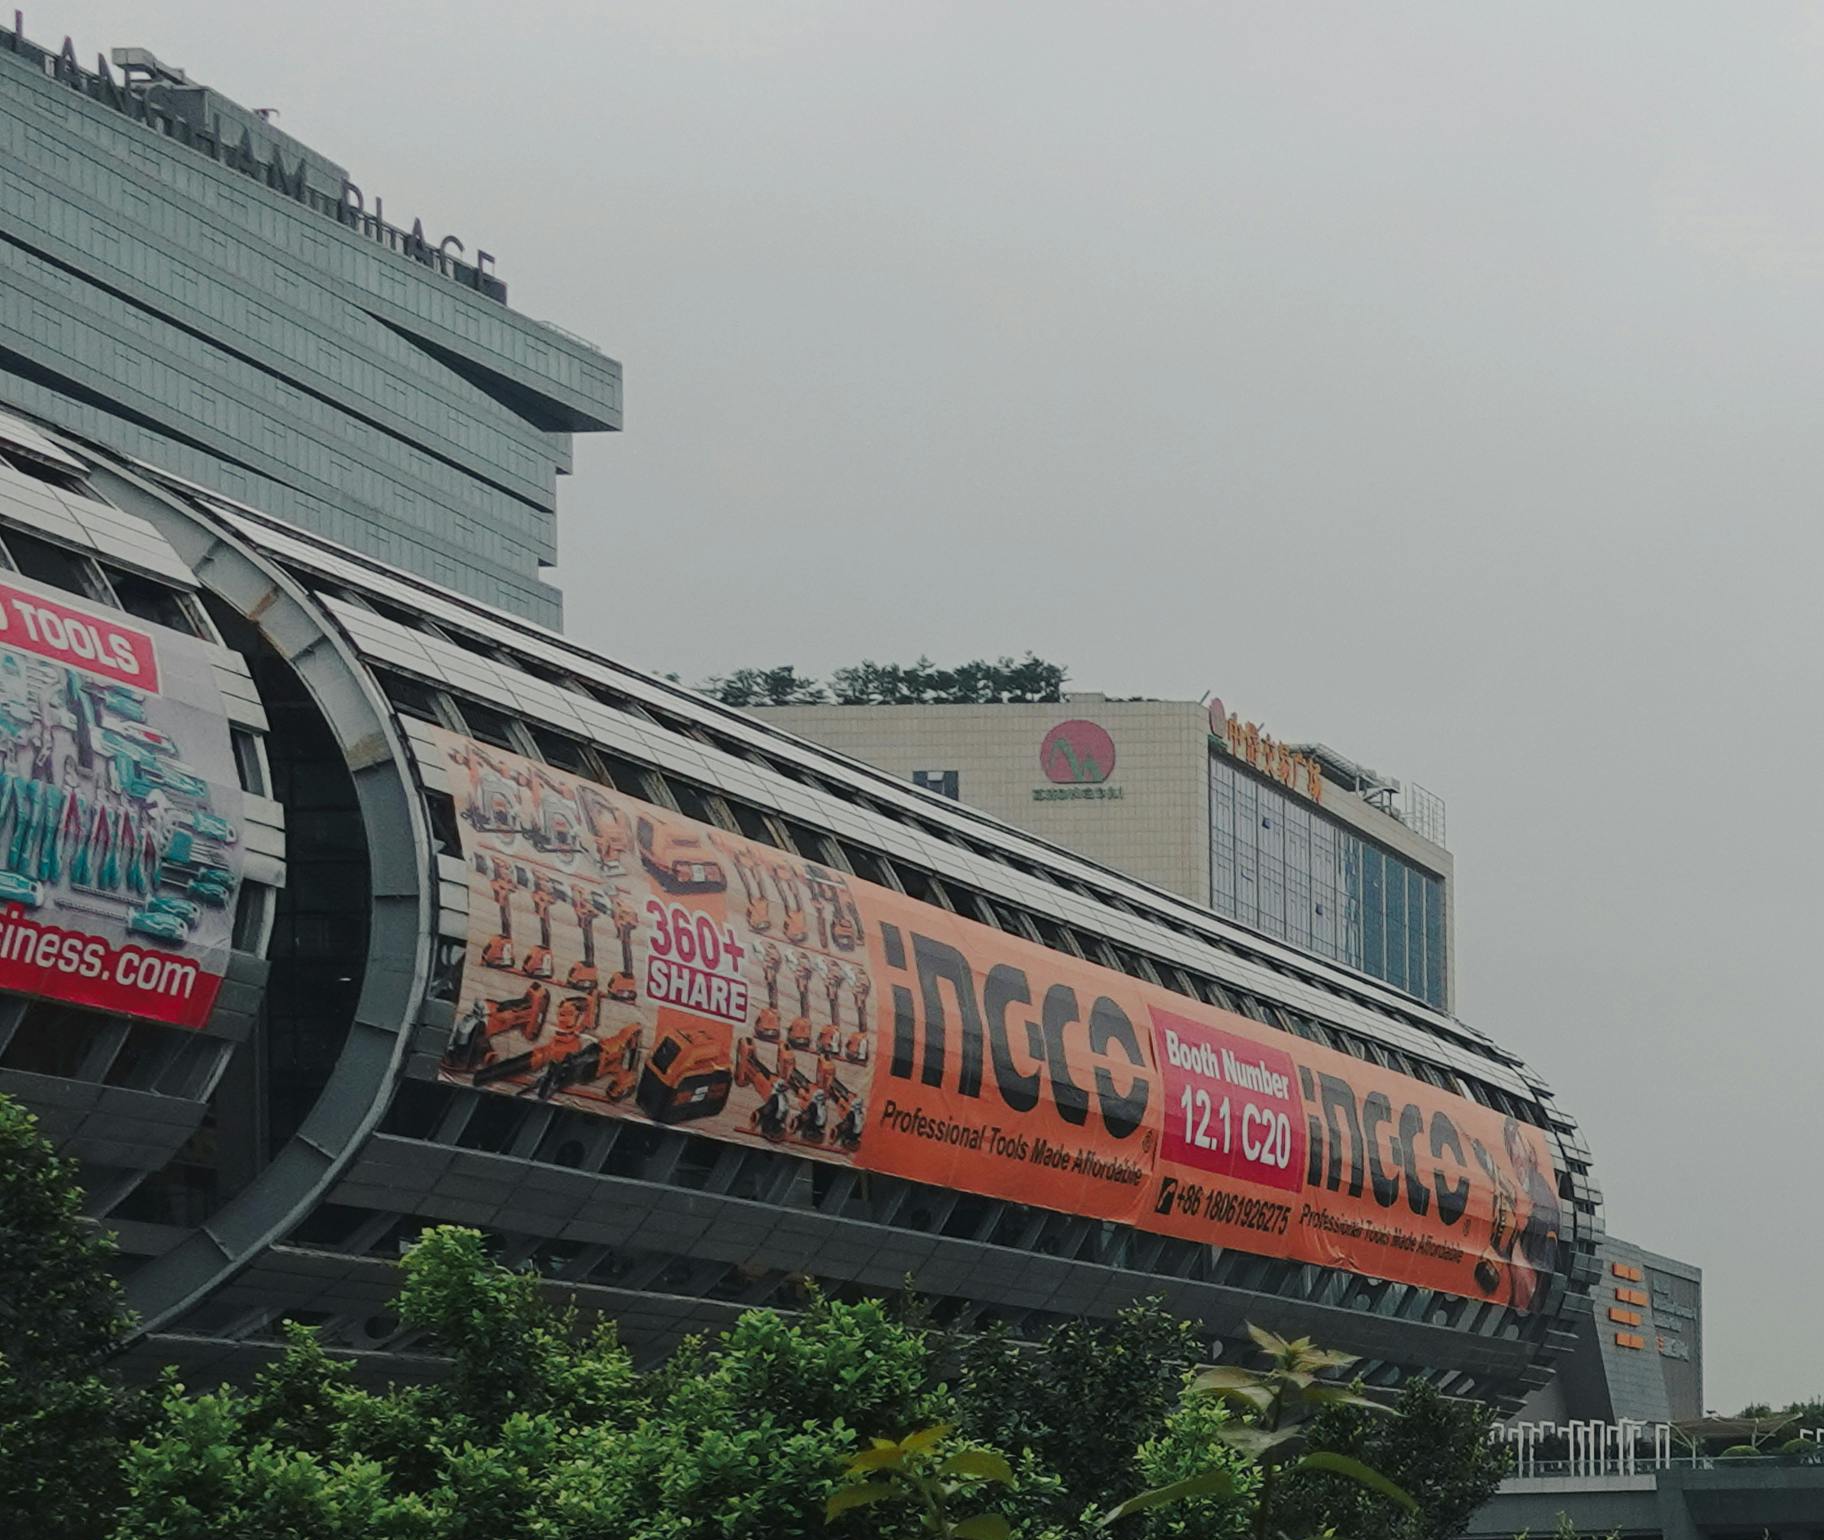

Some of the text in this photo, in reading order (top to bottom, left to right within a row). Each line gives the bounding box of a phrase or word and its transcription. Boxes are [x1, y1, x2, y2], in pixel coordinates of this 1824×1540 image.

[11, 598, 140, 675] TOOLS
[0, 909, 196, 999] iness.com
[646, 900, 744, 973] 360+
[649, 959, 747, 1019] SHARE
[1165, 1029, 1289, 1100] Booth Number
[880, 1099, 1143, 1187] Professional Tools Made Affordable
[1181, 1084, 1291, 1169] 12.1 C20
[1176, 1185, 1203, 1217] +86
[1299, 1203, 1364, 1238] Professional
[1392, 1226, 1418, 1253] Made
